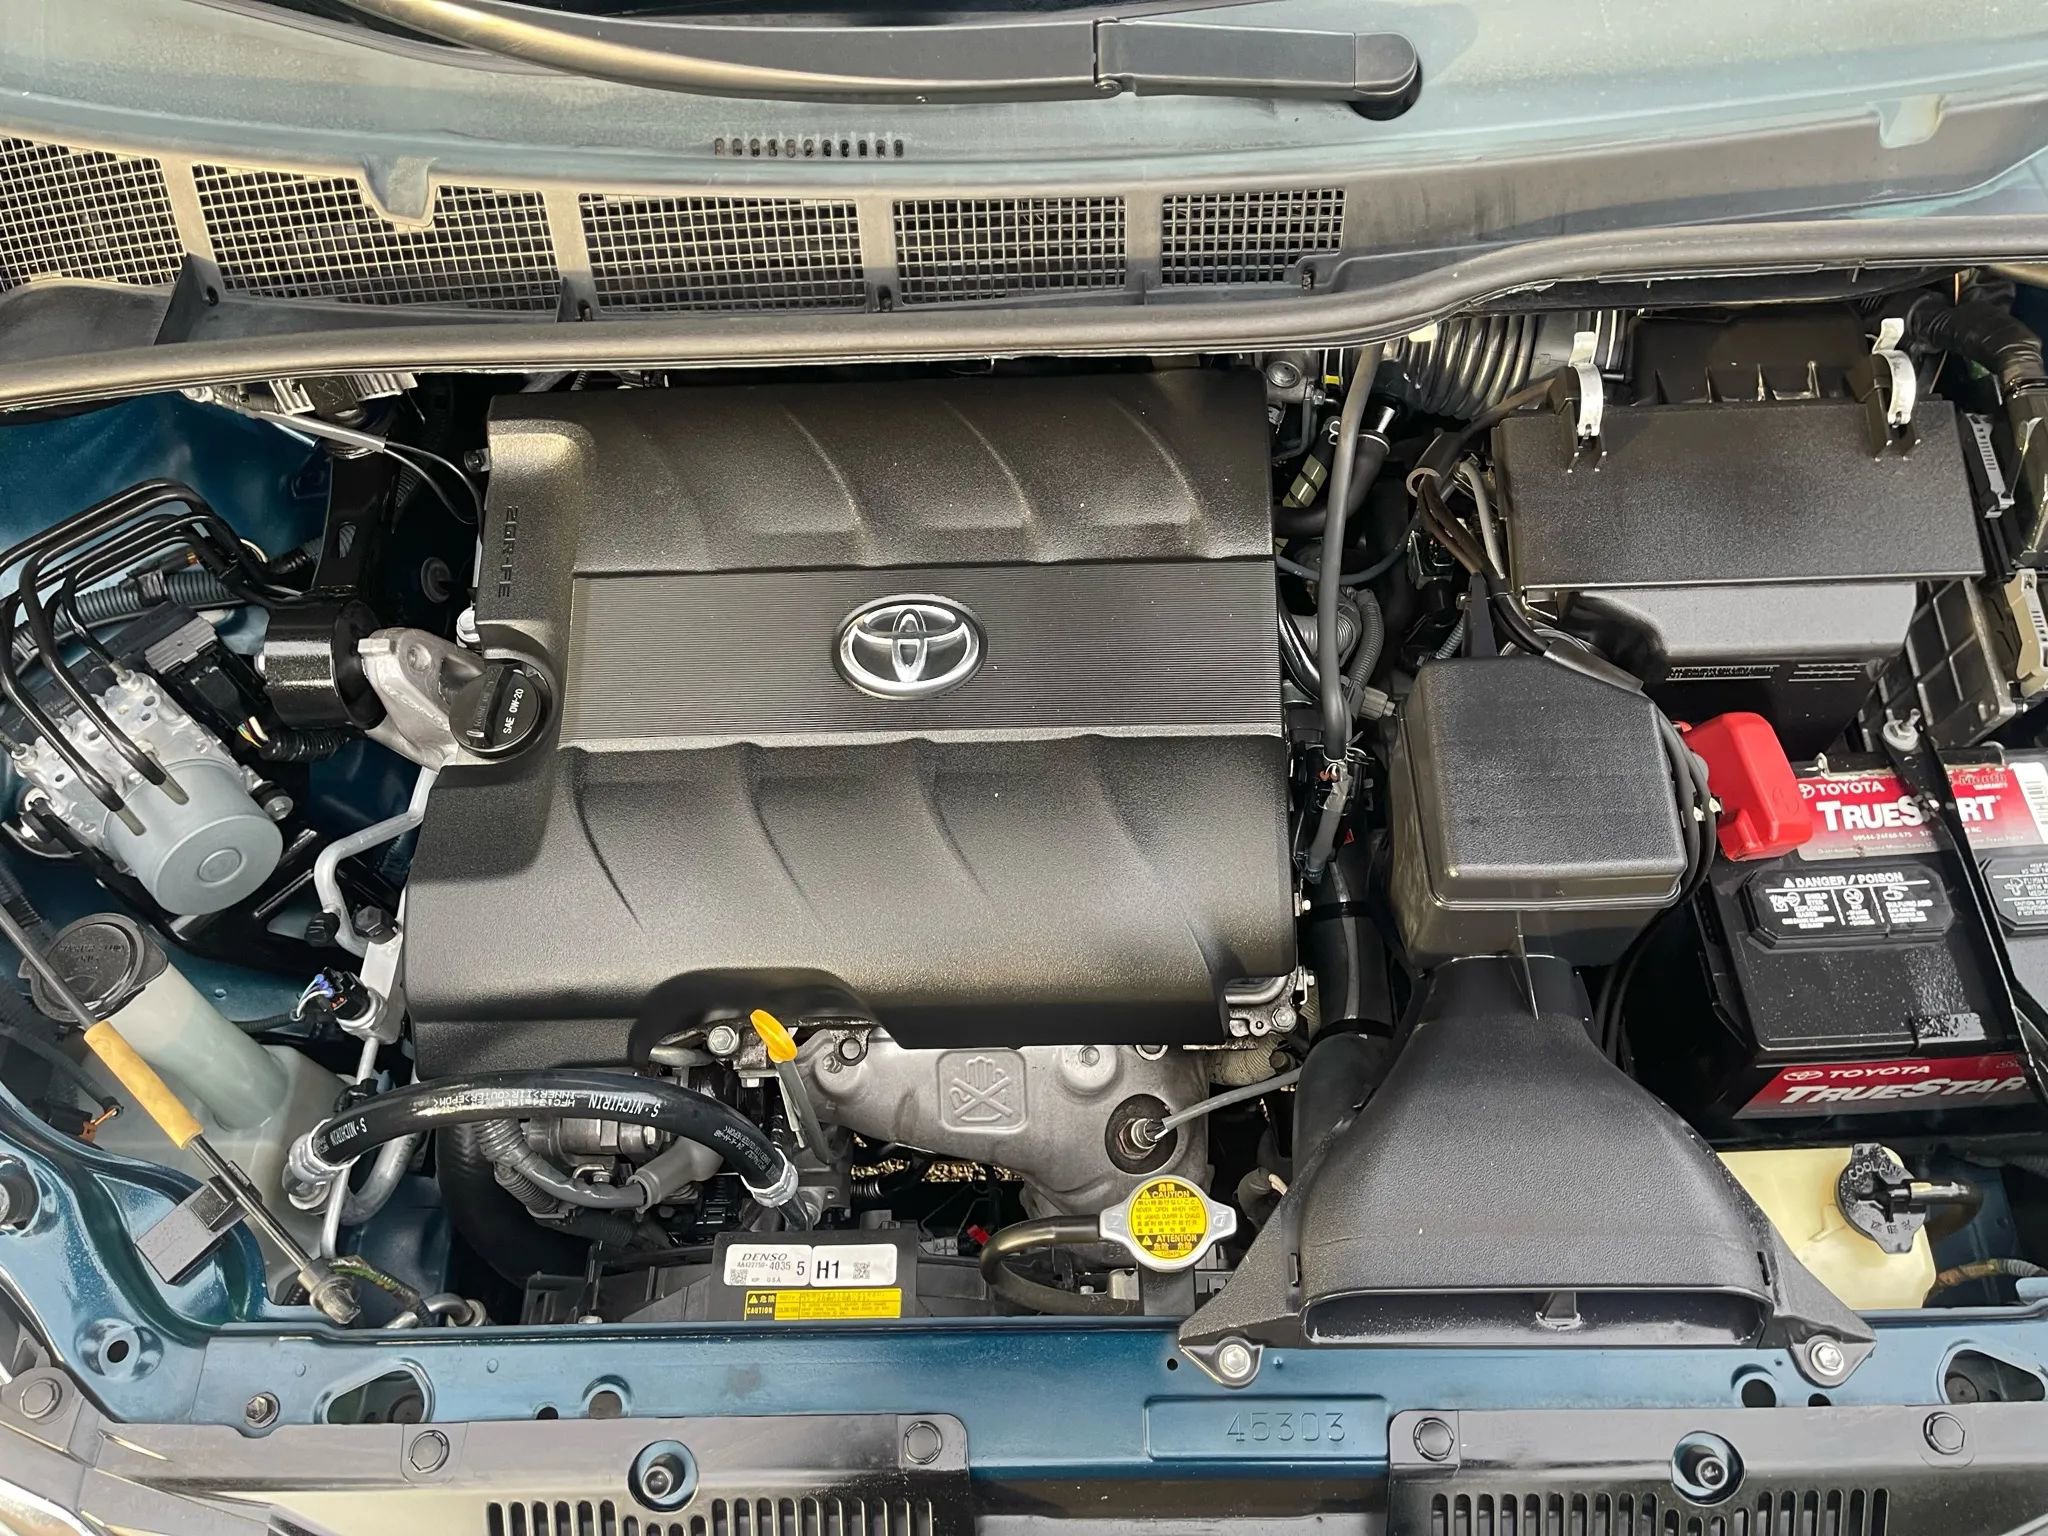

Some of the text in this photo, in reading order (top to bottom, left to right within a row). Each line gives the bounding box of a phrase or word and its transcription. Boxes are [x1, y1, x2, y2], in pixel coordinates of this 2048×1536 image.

[503, 687, 525, 735] SAE 0W-20
[1816, 779, 1886, 797] TOYOTA
[1795, 876, 1846, 889] DANGER
[1857, 871, 1905, 885] POISON
[1829, 1065, 1932, 1080] TOYOTA
[1847, 1160, 1902, 1180] COOLANT
[1151, 1190, 1191, 1199] CAUTION
[1156, 1234, 1198, 1243] ATTENTION
[741, 1252, 788, 1261] DENSO
[796, 1260, 806, 1277] 5
[816, 1259, 841, 1280] H1
[745, 1306, 773, 1315] CAUTION
[1226, 1411, 1346, 1442] 45303
